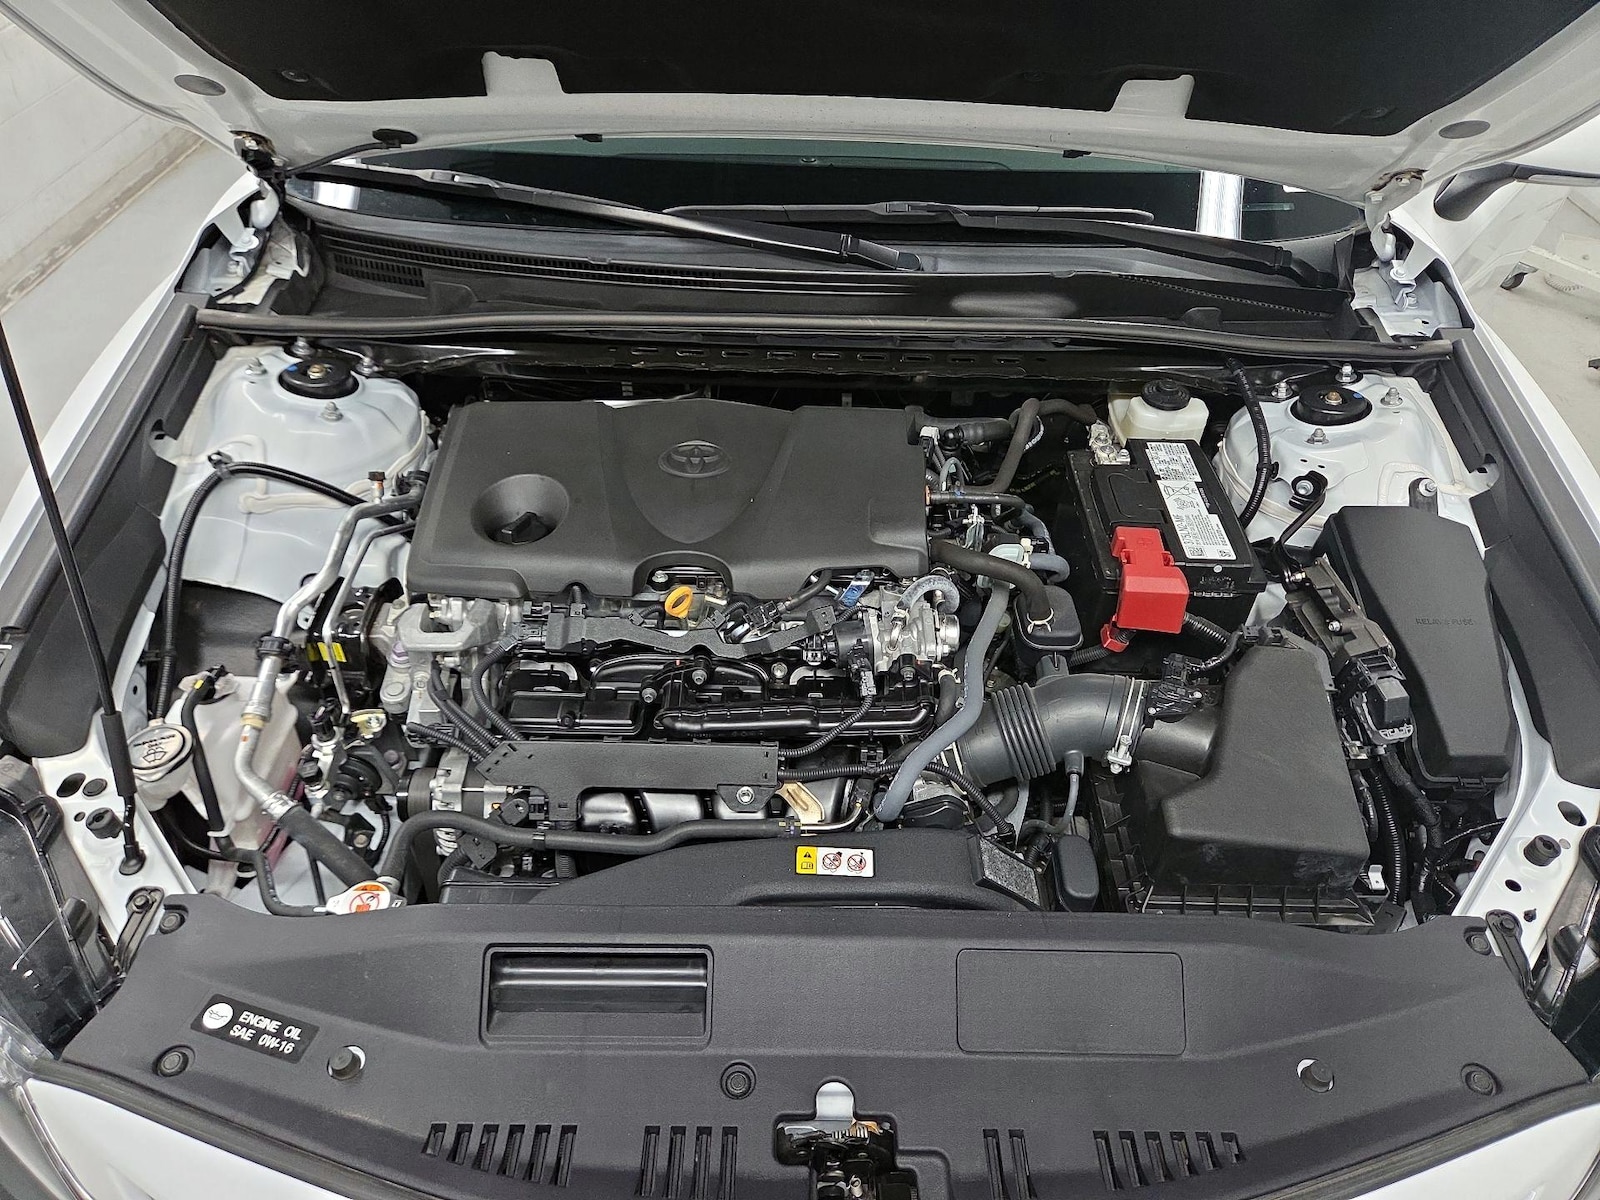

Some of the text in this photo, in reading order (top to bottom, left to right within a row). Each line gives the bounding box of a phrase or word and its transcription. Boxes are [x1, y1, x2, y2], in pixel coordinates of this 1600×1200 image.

[1451, 618, 1475, 626] FUSE
[229, 1024, 295, 1054] SAE 0W-16
[238, 1011, 303, 1041] ENGINE OIL
